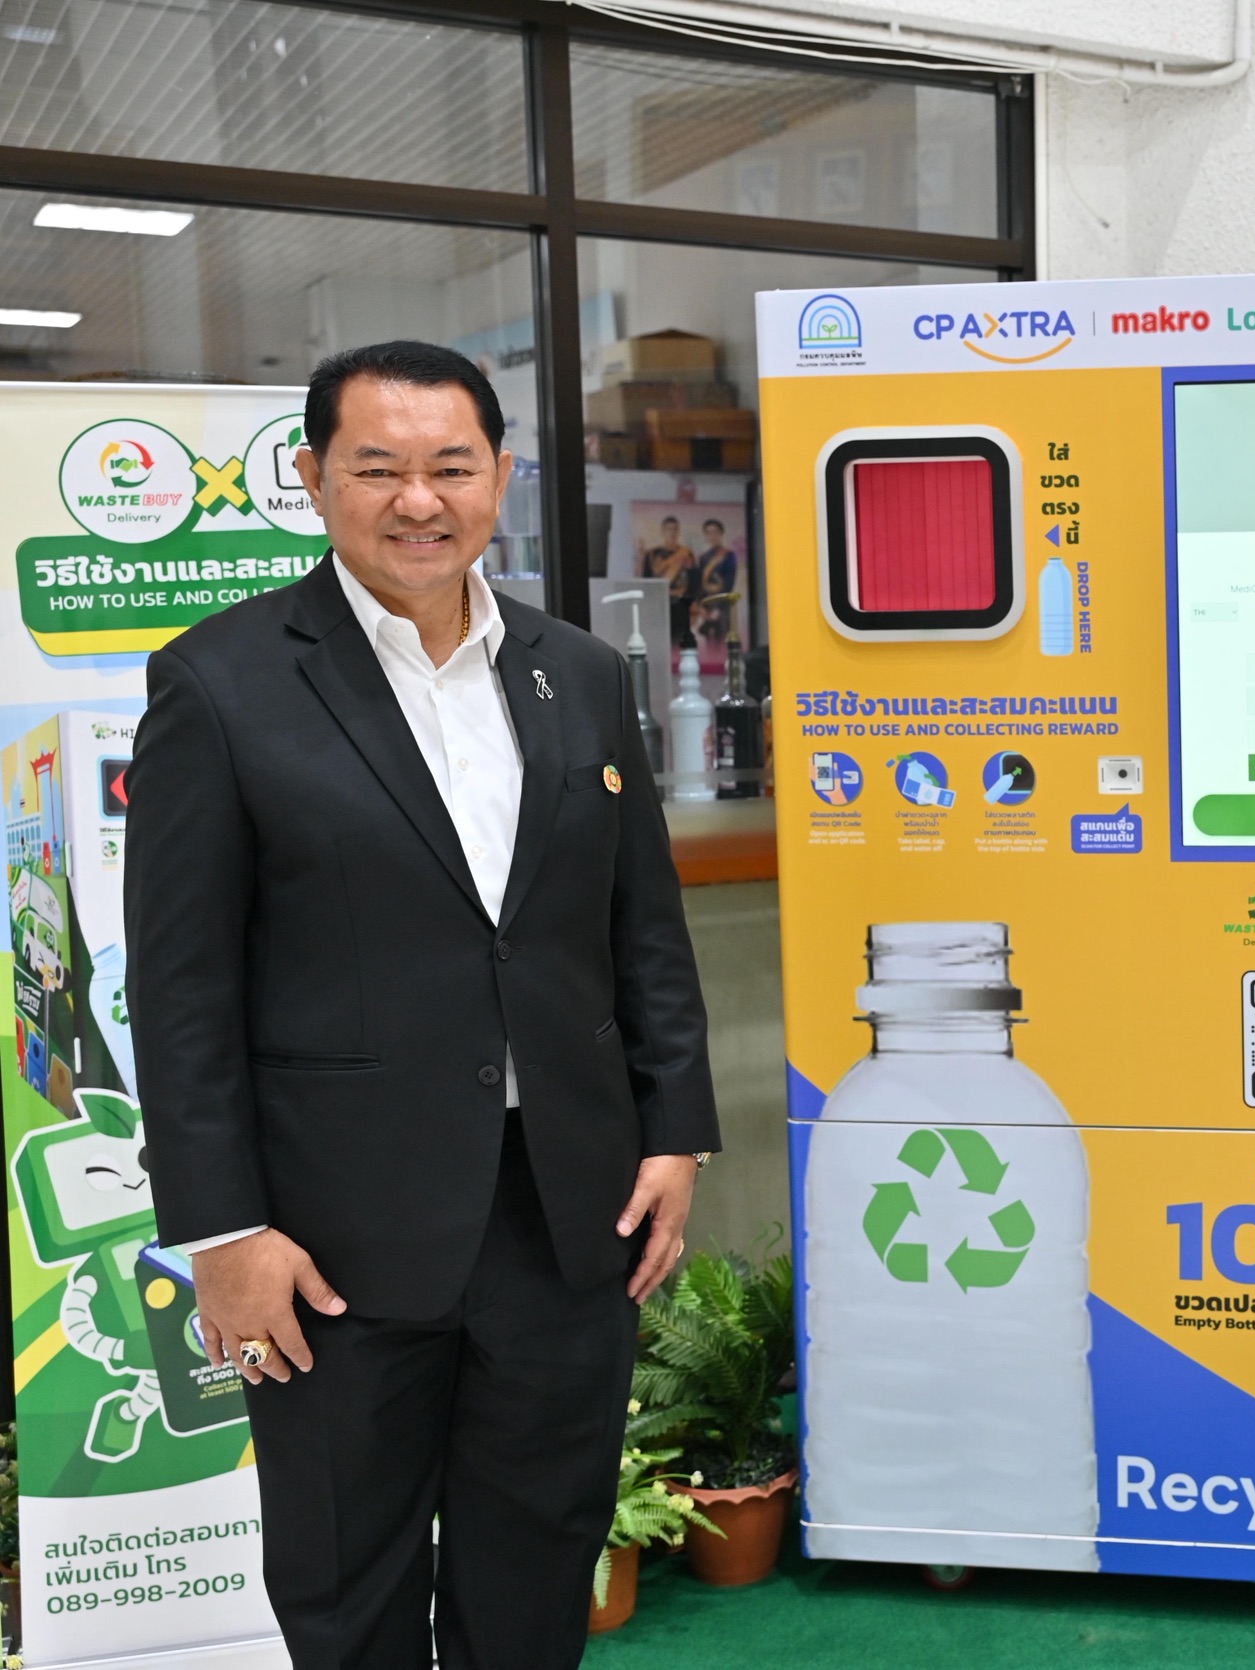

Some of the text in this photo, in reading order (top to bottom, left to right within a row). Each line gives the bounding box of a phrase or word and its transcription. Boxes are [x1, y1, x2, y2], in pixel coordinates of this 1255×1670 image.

[913, 310, 1076, 340] CP AXTRA
[1111, 305, 1210, 334] makro
[1047, 442, 1070, 461] ใส่
[1040, 474, 1080, 488] ขวด
[107, 512, 161, 523] Delivery
[1041, 502, 1080, 516] ตรง
[1066, 521, 1080, 545] นี้
[35, 555, 326, 587] วิธีใช้งานและสะสม
[50, 595, 94, 611] HOW
[100, 593, 125, 608] TO
[131, 591, 167, 607] USE
[173, 589, 213, 605] AND
[1077, 561, 1092, 654] DROP HERE
[796, 691, 1117, 716] วิธีใช้งานและสะสมคะแนน
[802, 722, 1119, 736] HOW TO USE AND COLLECTING REWARD
[1080, 817, 1134, 831] สแกนเพื่อ
[1081, 830, 1134, 842] สะสมแต้ม
[1174, 1315, 1222, 1330] Empty
[45, 1519, 260, 1559] สนใจติดต่อสอบถา
[46, 1554, 187, 1586] เพิ่มเติม โทร
[47, 1573, 246, 1614] 089-998-2009
